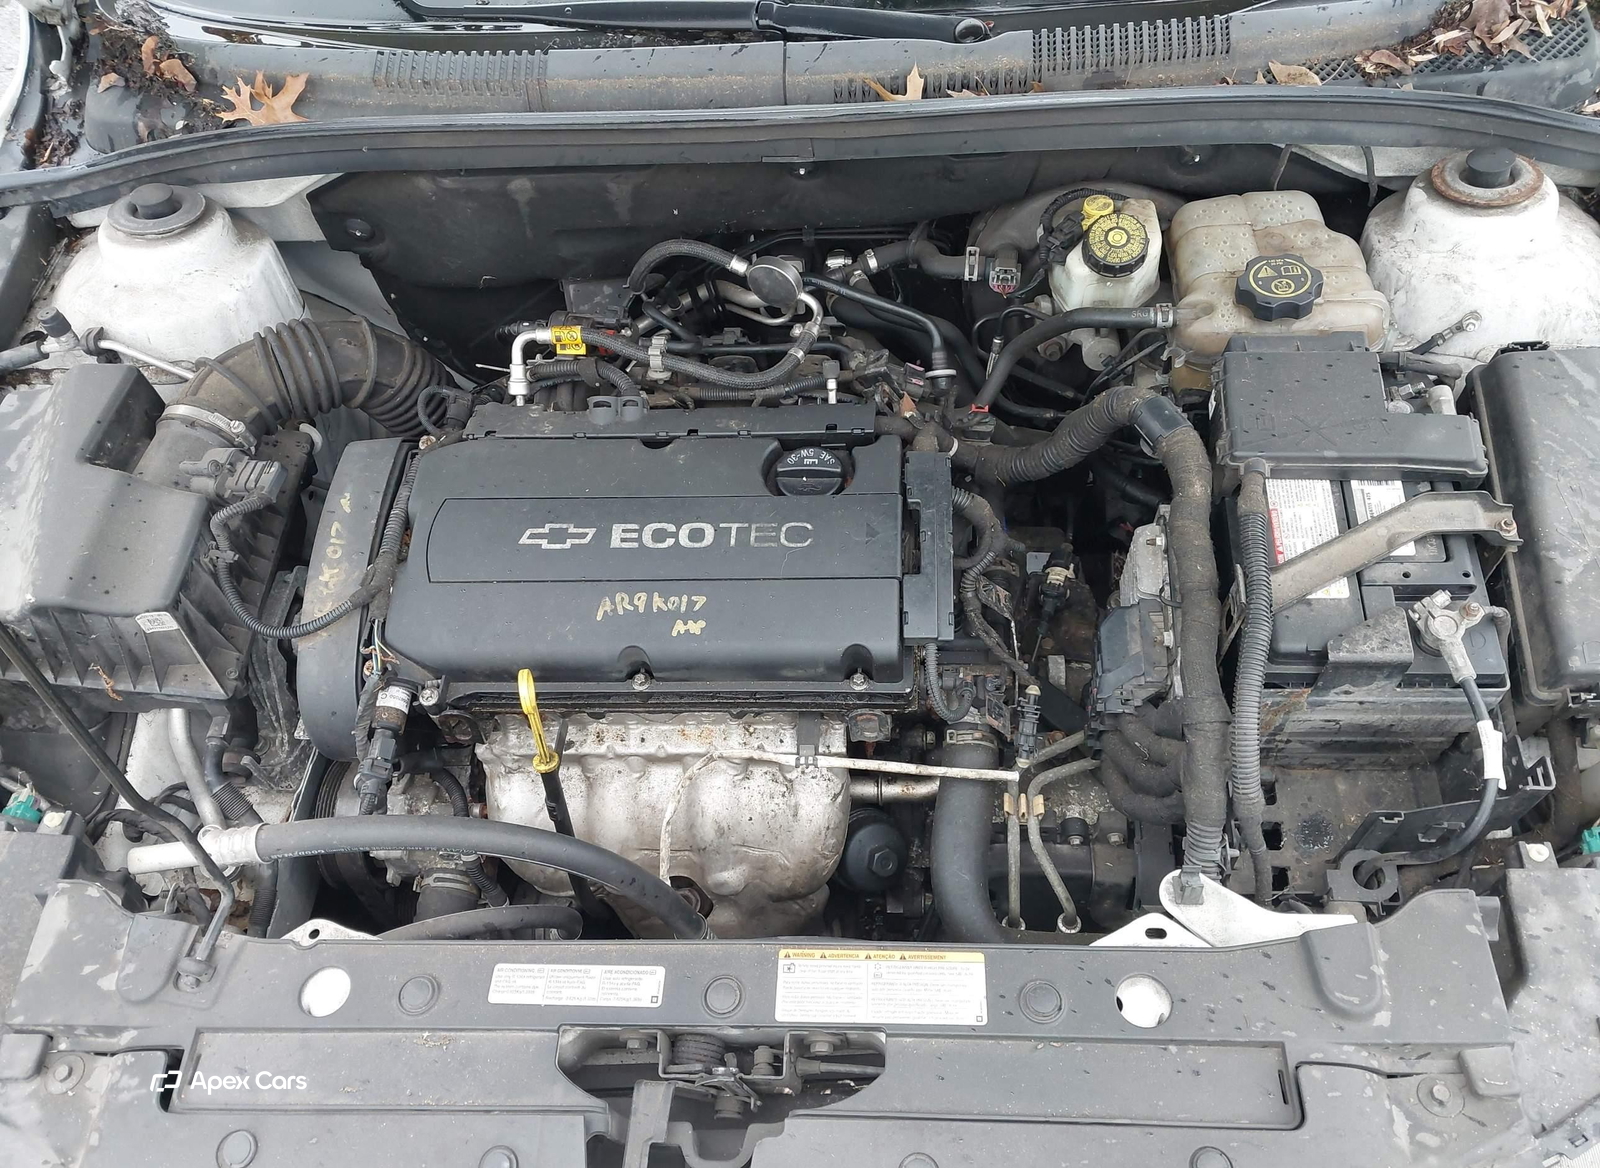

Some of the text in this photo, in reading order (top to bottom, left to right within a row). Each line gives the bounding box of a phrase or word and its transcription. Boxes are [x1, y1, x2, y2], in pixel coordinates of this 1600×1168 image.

[1131, 310, 1148, 318] SRG
[786, 448, 836, 464] SAE 5W-30
[609, 522, 814, 549] ECOTEC
[270, 848, 324, 858] GOODYEAR
